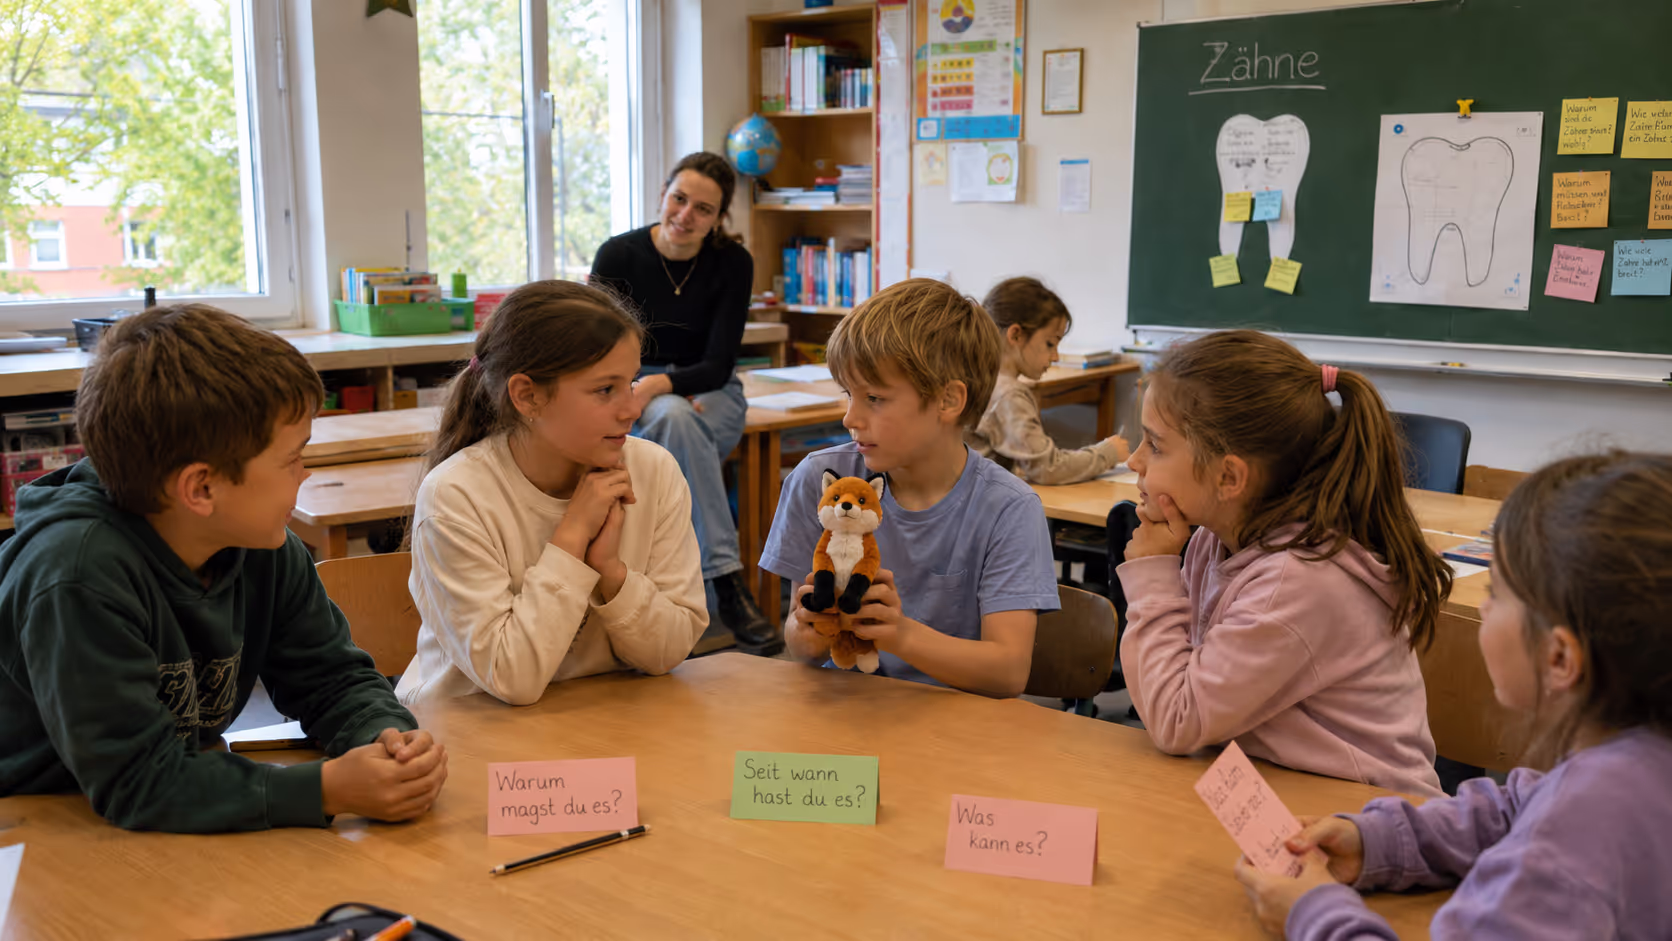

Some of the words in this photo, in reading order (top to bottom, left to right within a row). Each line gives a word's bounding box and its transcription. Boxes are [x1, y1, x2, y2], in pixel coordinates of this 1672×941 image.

[1200, 42, 1320, 83] Zähne
[496, 770, 565, 792] Warum
[743, 758, 780, 781] Seit
[791, 767, 839, 783] wann
[501, 797, 556, 826] magst
[564, 796, 587, 816] du
[592, 789, 623, 815] es?
[753, 785, 793, 806] hast
[802, 787, 827, 807] du
[835, 785, 866, 809] es?
[956, 801, 995, 827] Was
[969, 831, 1010, 852] kann
[1015, 830, 1048, 857] es?
